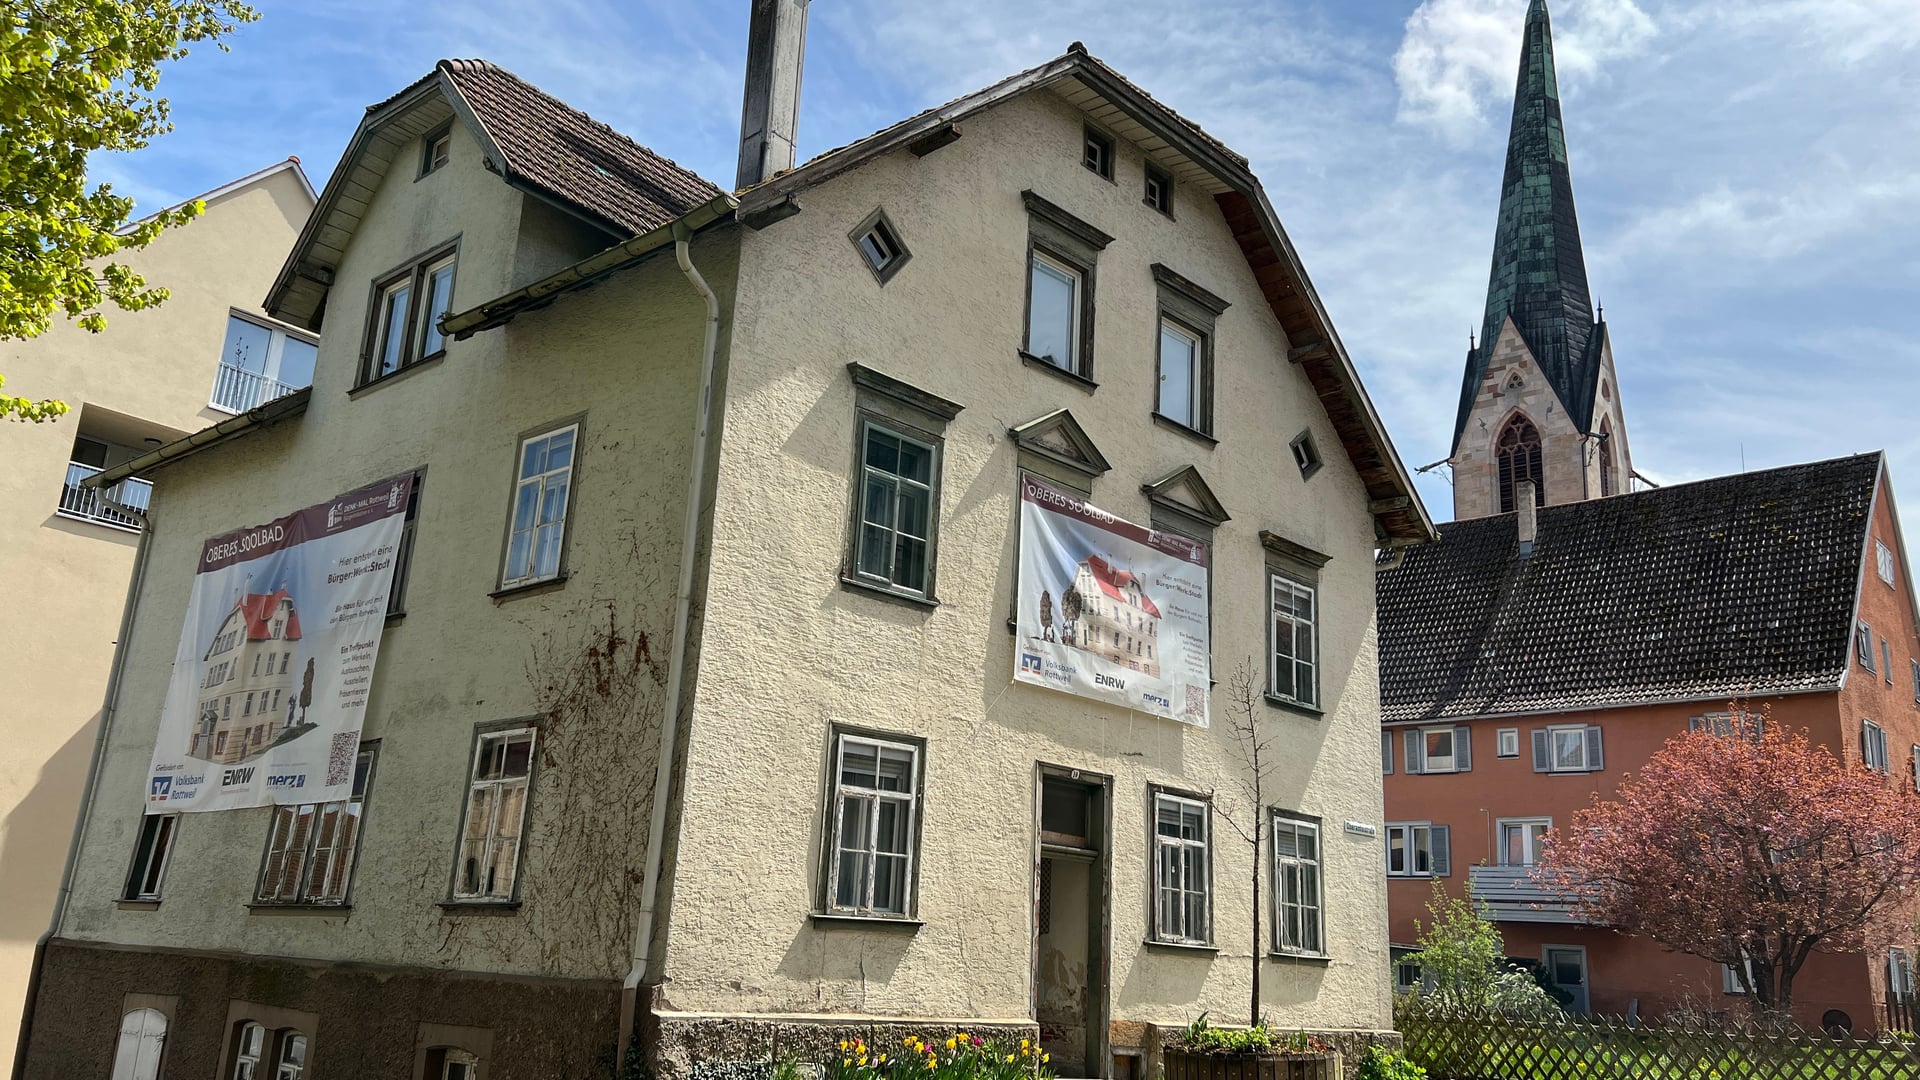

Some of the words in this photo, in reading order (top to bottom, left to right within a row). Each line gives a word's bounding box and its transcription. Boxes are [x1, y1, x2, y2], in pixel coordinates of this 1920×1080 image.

[1027, 484, 1066, 507] OBERES
[1068, 499, 1115, 525] SOOLBAD
[205, 540, 239, 563] OBERES
[239, 525, 284, 553] SOOLBAD
[377, 545, 393, 556] eine
[1045, 658, 1077, 674] Volksbank
[1044, 669, 1072, 683] Rottweil
[1095, 673, 1125, 690] ENRW
[1142, 692, 1163, 706] merz
[175, 772, 205, 786] Volksbank
[222, 766, 256, 787] ENRW
[266, 775, 297, 788] merz
[170, 787, 198, 800] Rottweil
